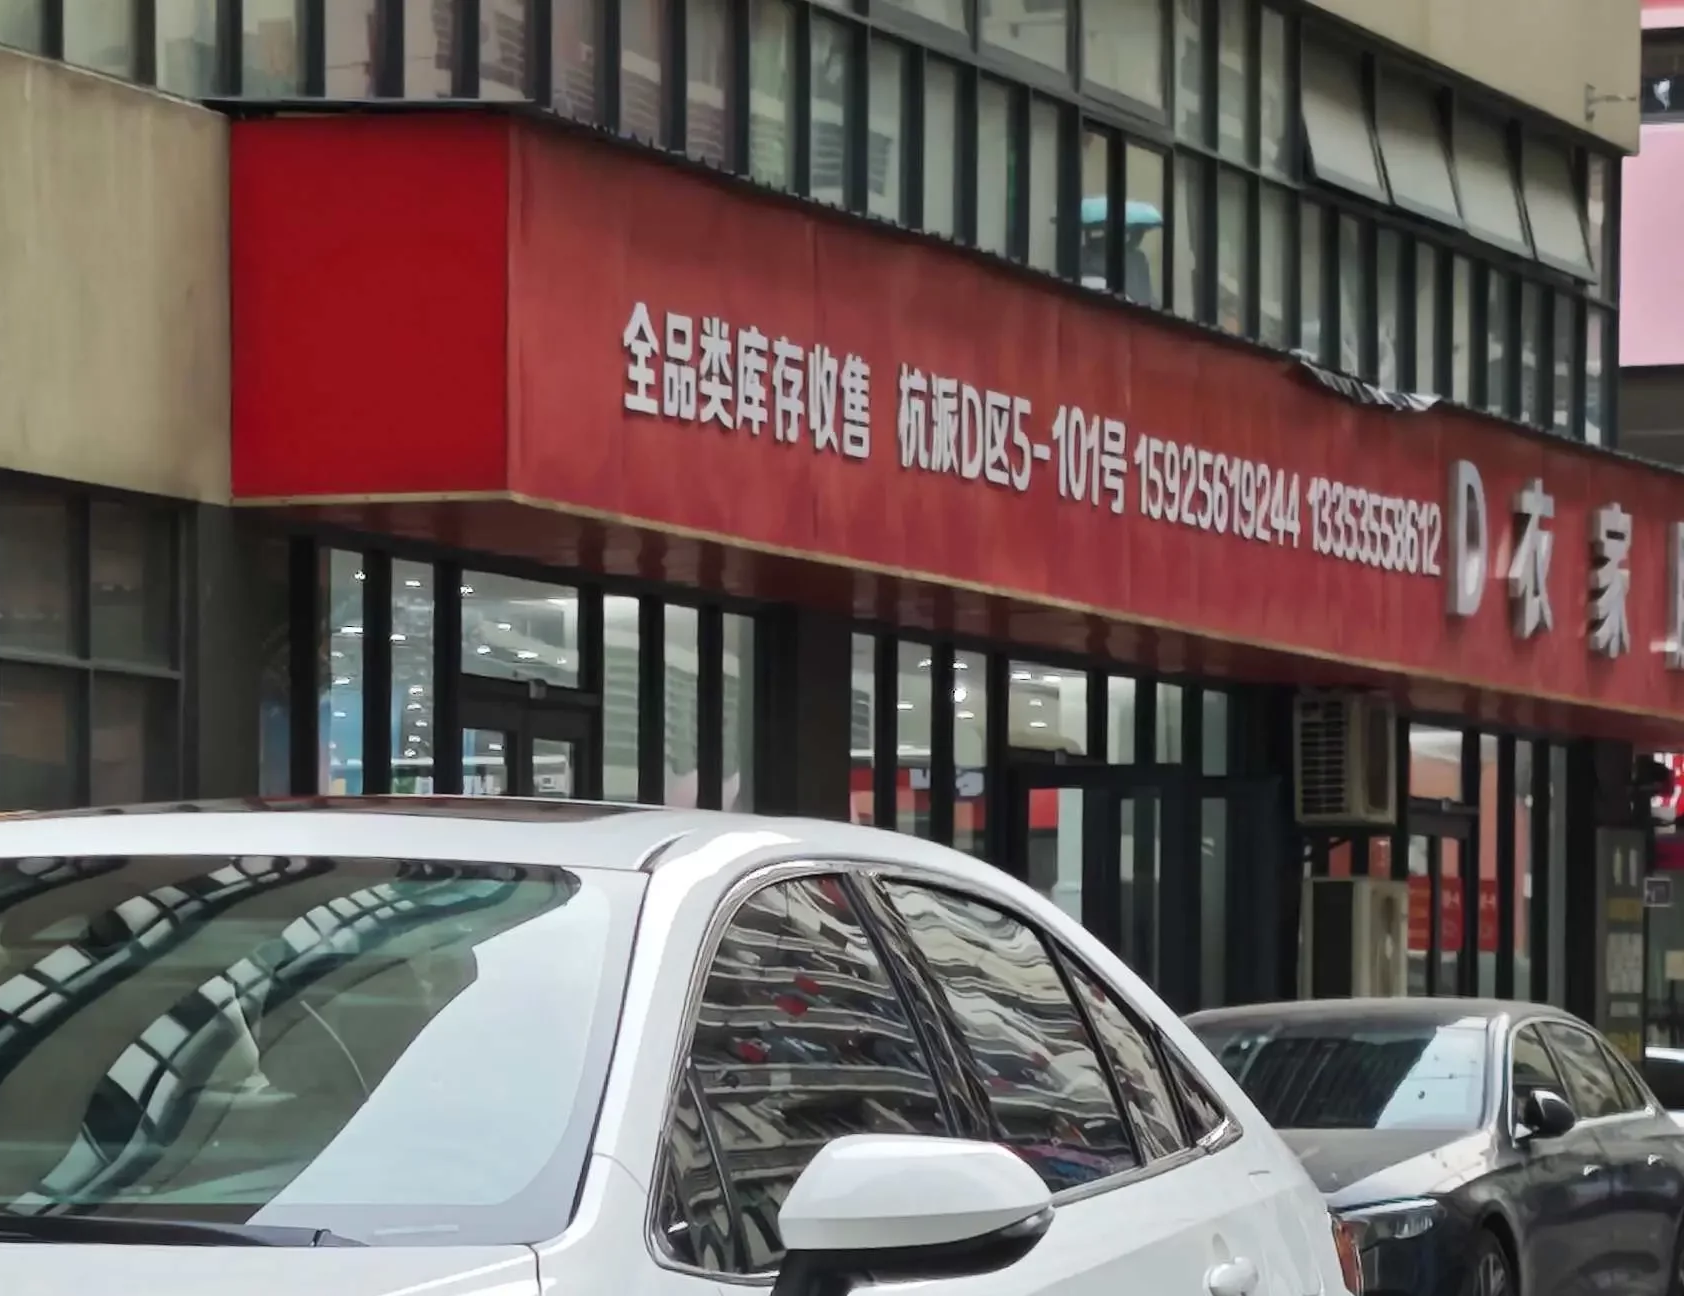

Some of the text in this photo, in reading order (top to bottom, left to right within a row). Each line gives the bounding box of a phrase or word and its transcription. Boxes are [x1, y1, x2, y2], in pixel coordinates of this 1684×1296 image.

[623, 302, 871, 460] 全品类库存收售
[898, 363, 1128, 515] 杭派D区5-101号
[1134, 432, 1301, 549] 15925619244
[1447, 459, 1684, 671] D衣家
